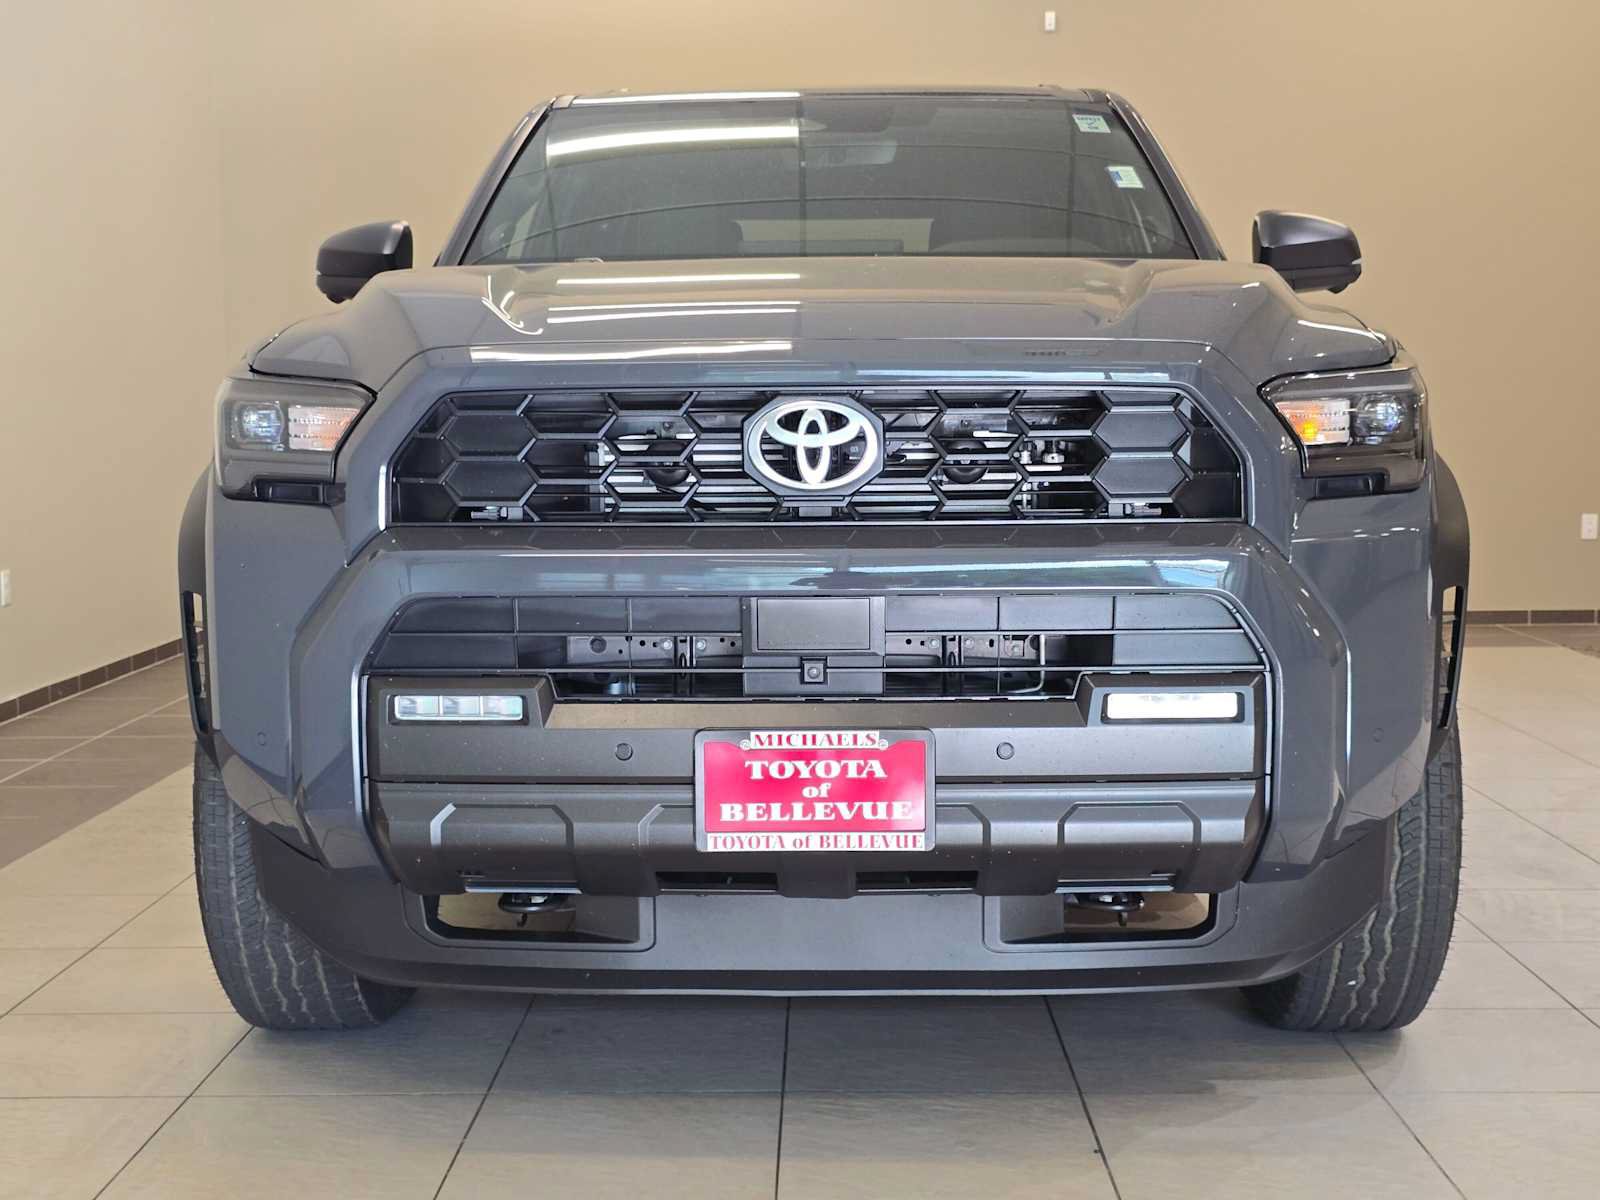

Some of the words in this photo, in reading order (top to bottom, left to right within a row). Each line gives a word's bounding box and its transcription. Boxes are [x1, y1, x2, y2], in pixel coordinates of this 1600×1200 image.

[753, 733, 877, 747] MICHAELS
[744, 760, 887, 780] TOYOTA
[802, 782, 832, 798] of
[720, 801, 913, 822] BELLEVUE
[710, 835, 786, 850] TOYOTA
[793, 834, 814, 849] of
[820, 834, 923, 849] BELLEVUE
